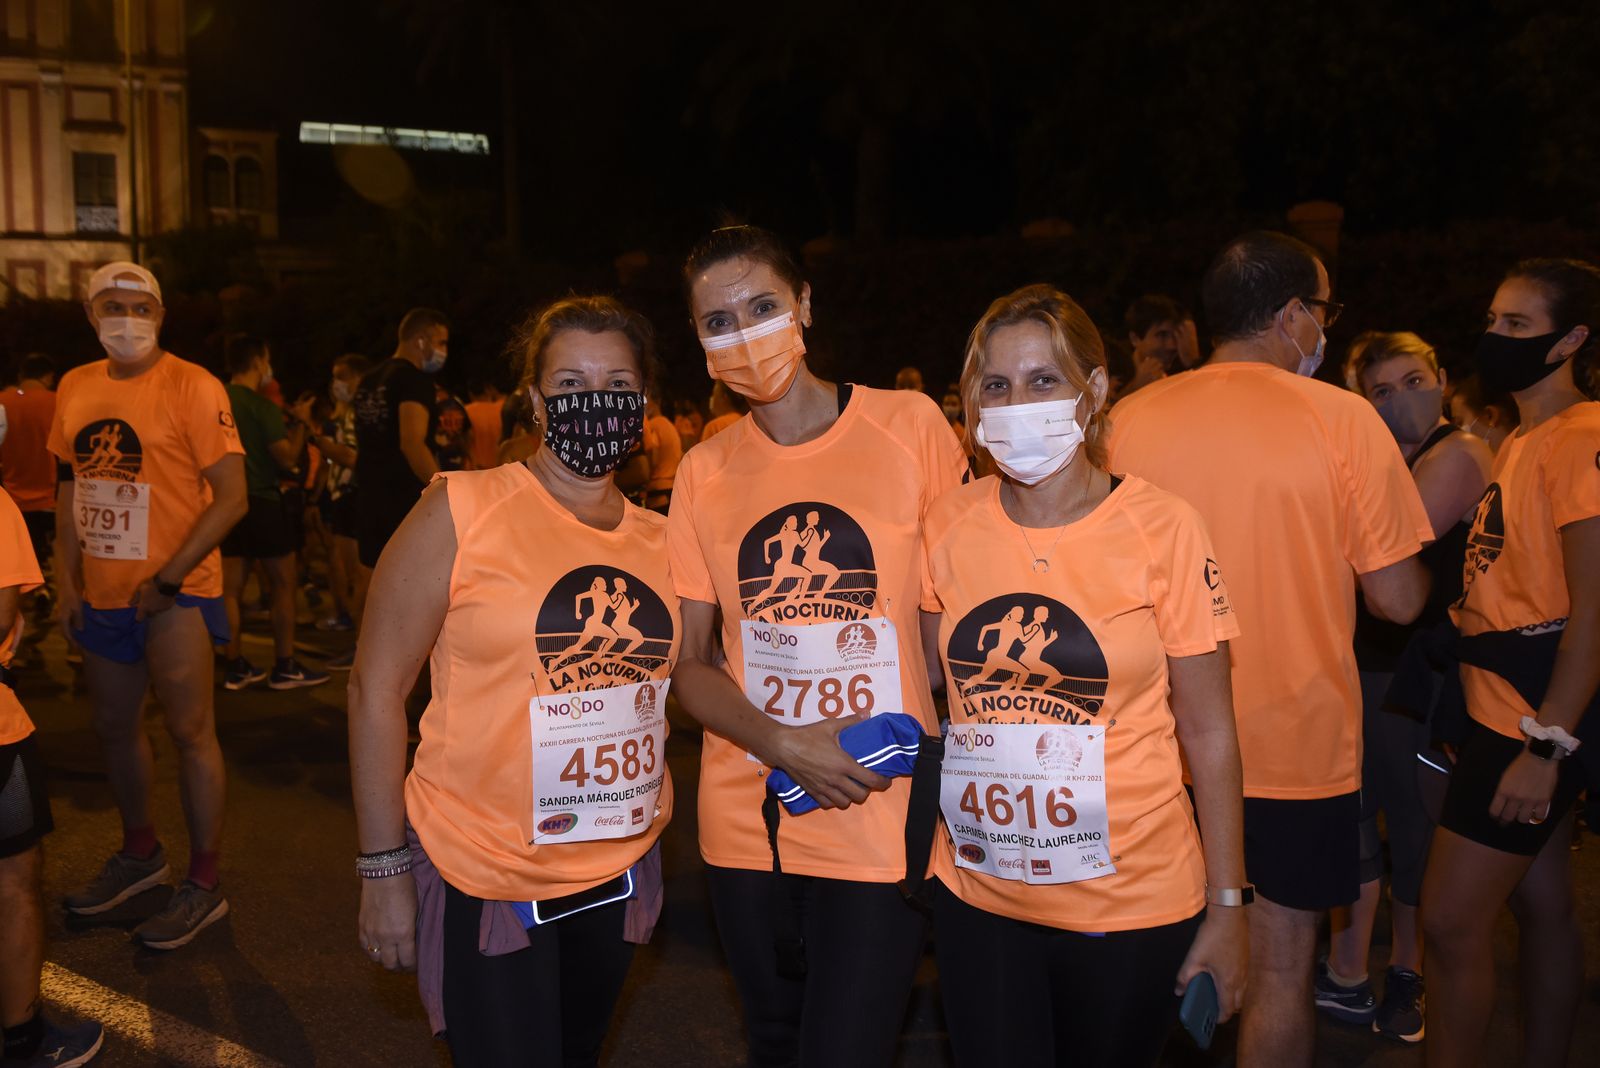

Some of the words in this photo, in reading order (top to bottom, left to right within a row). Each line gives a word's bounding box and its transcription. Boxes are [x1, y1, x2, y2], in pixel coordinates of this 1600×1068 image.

[80, 505, 131, 531] 3791
[773, 603, 870, 622] NOCTURNA
[549, 672, 575, 691] LA
[577, 662, 650, 683] NOCTURN
[762, 664, 783, 672] CARRERA
[826, 663, 868, 674] GUADALQUIVIR
[763, 673, 875, 719] 2786
[963, 702, 979, 717] LA
[982, 695, 1091, 725] NOCTURNA
[558, 737, 585, 746] CARRERA
[587, 731, 618, 742] NOCTURNA
[560, 734, 656, 788] 4583
[954, 769, 977, 777] CARRERA
[539, 795, 585, 807] SANDRA
[587, 788, 635, 804] MÁRQUEZ
[959, 781, 1078, 829] 4616
[543, 818, 571, 831] KH7
[954, 823, 988, 841] CARMEN
[989, 832, 1036, 848] SANCHEZ
[1037, 831, 1102, 848] LAUREANO
[1081, 852, 1100, 863] ABC
